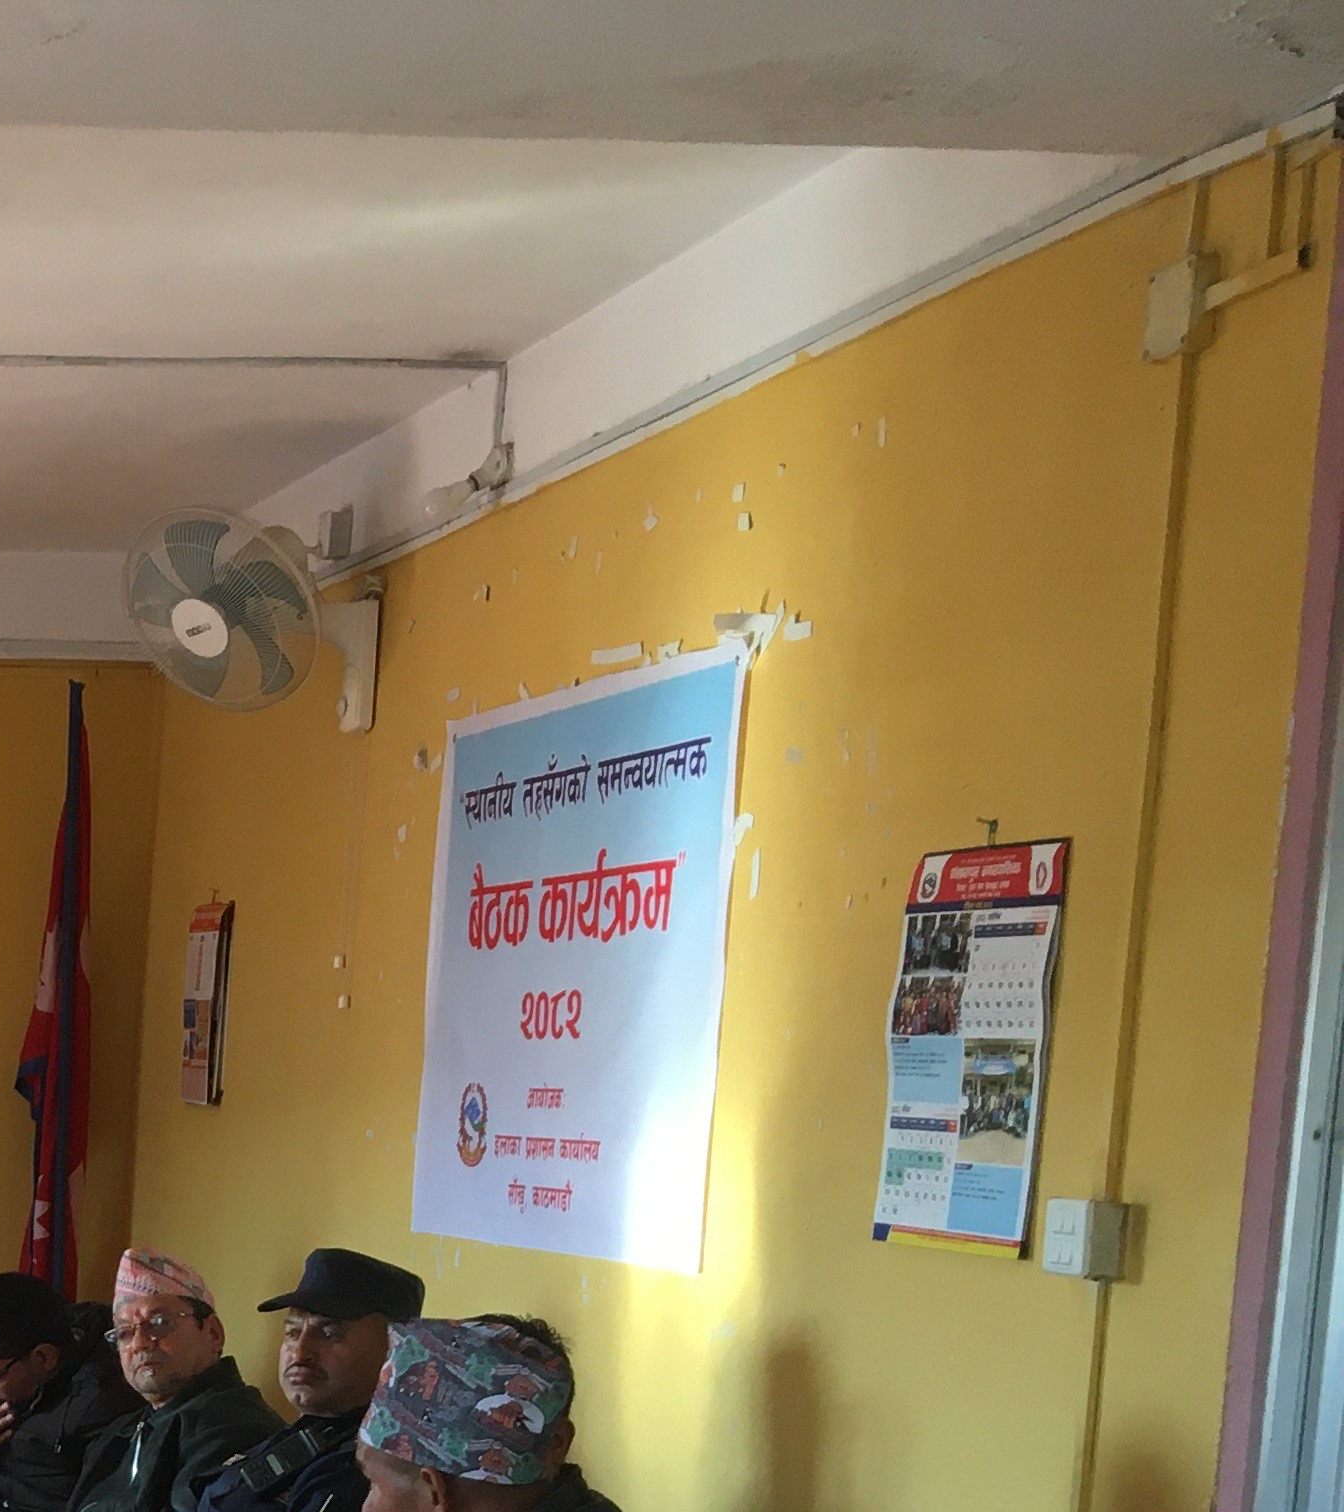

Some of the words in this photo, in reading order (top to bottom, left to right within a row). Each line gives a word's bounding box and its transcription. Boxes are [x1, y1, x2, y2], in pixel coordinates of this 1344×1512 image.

[597, 736, 712, 805] समन्वयात्मक
[468, 863, 534, 951] बैठक
[520, 989, 583, 1040] २०८२
[494, 1134, 522, 1159] इलाका
[559, 1132, 601, 1163] कार्यालय
